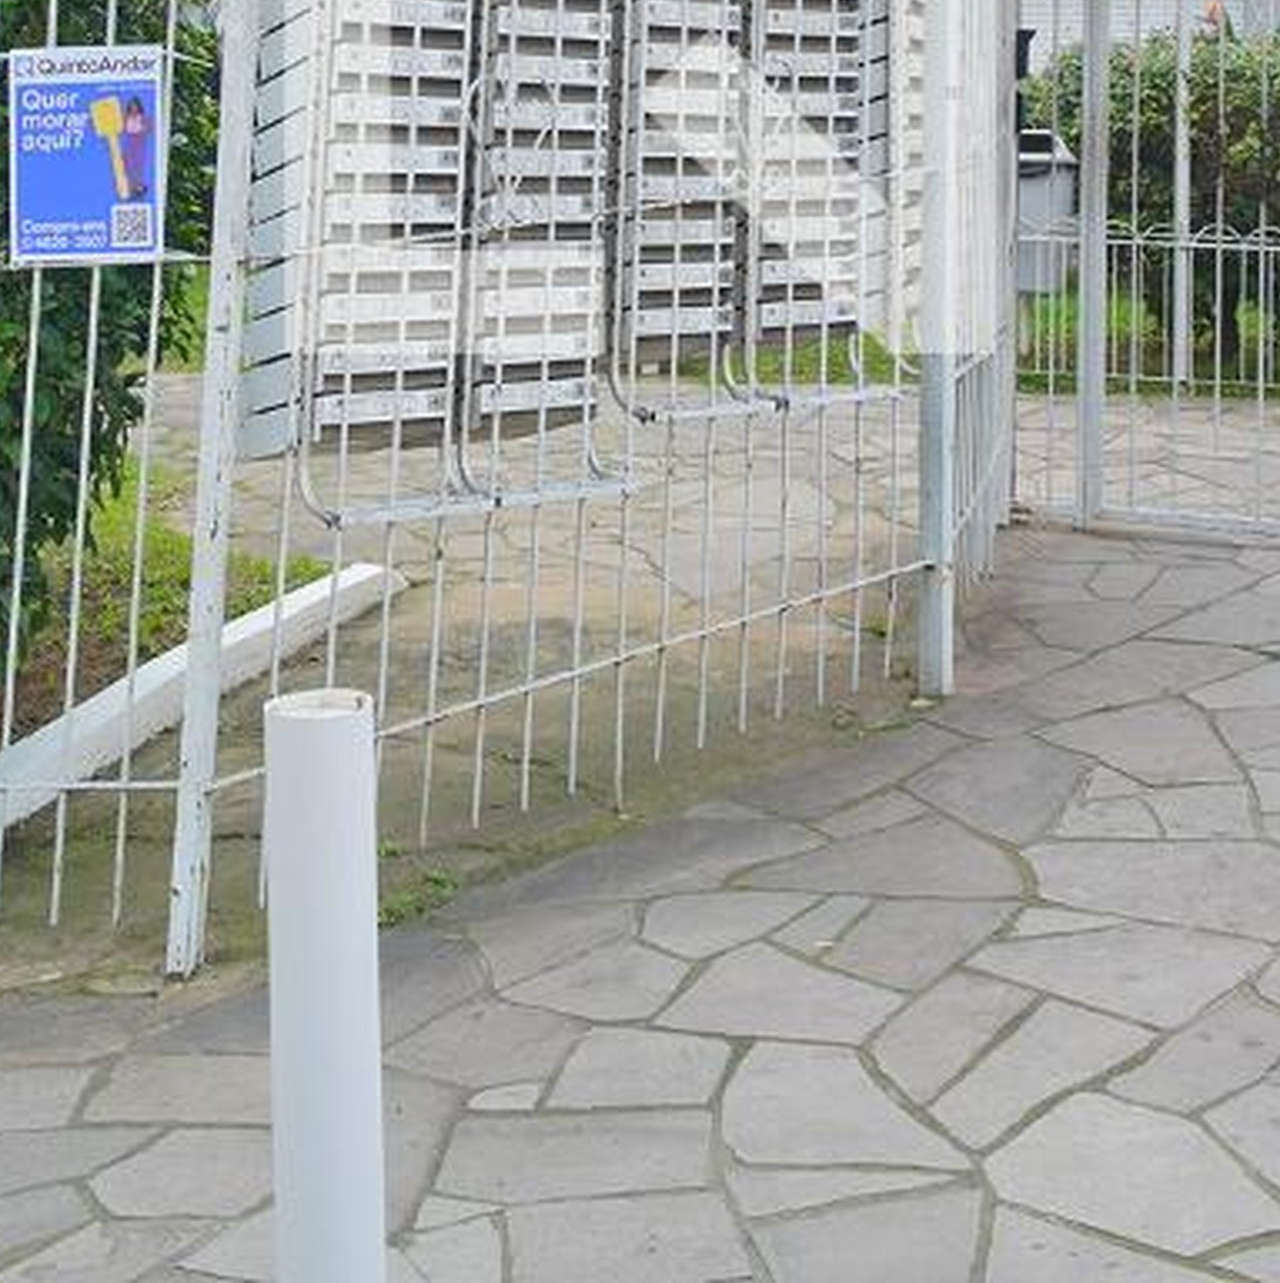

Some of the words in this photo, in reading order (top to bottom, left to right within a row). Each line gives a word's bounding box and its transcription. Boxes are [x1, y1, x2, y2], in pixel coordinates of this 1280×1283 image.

[37, 57, 156, 75] QuintoAndar
[22, 89, 79, 111] Quer
[22, 112, 90, 130] morar
[22, 129, 84, 153] aqui?
